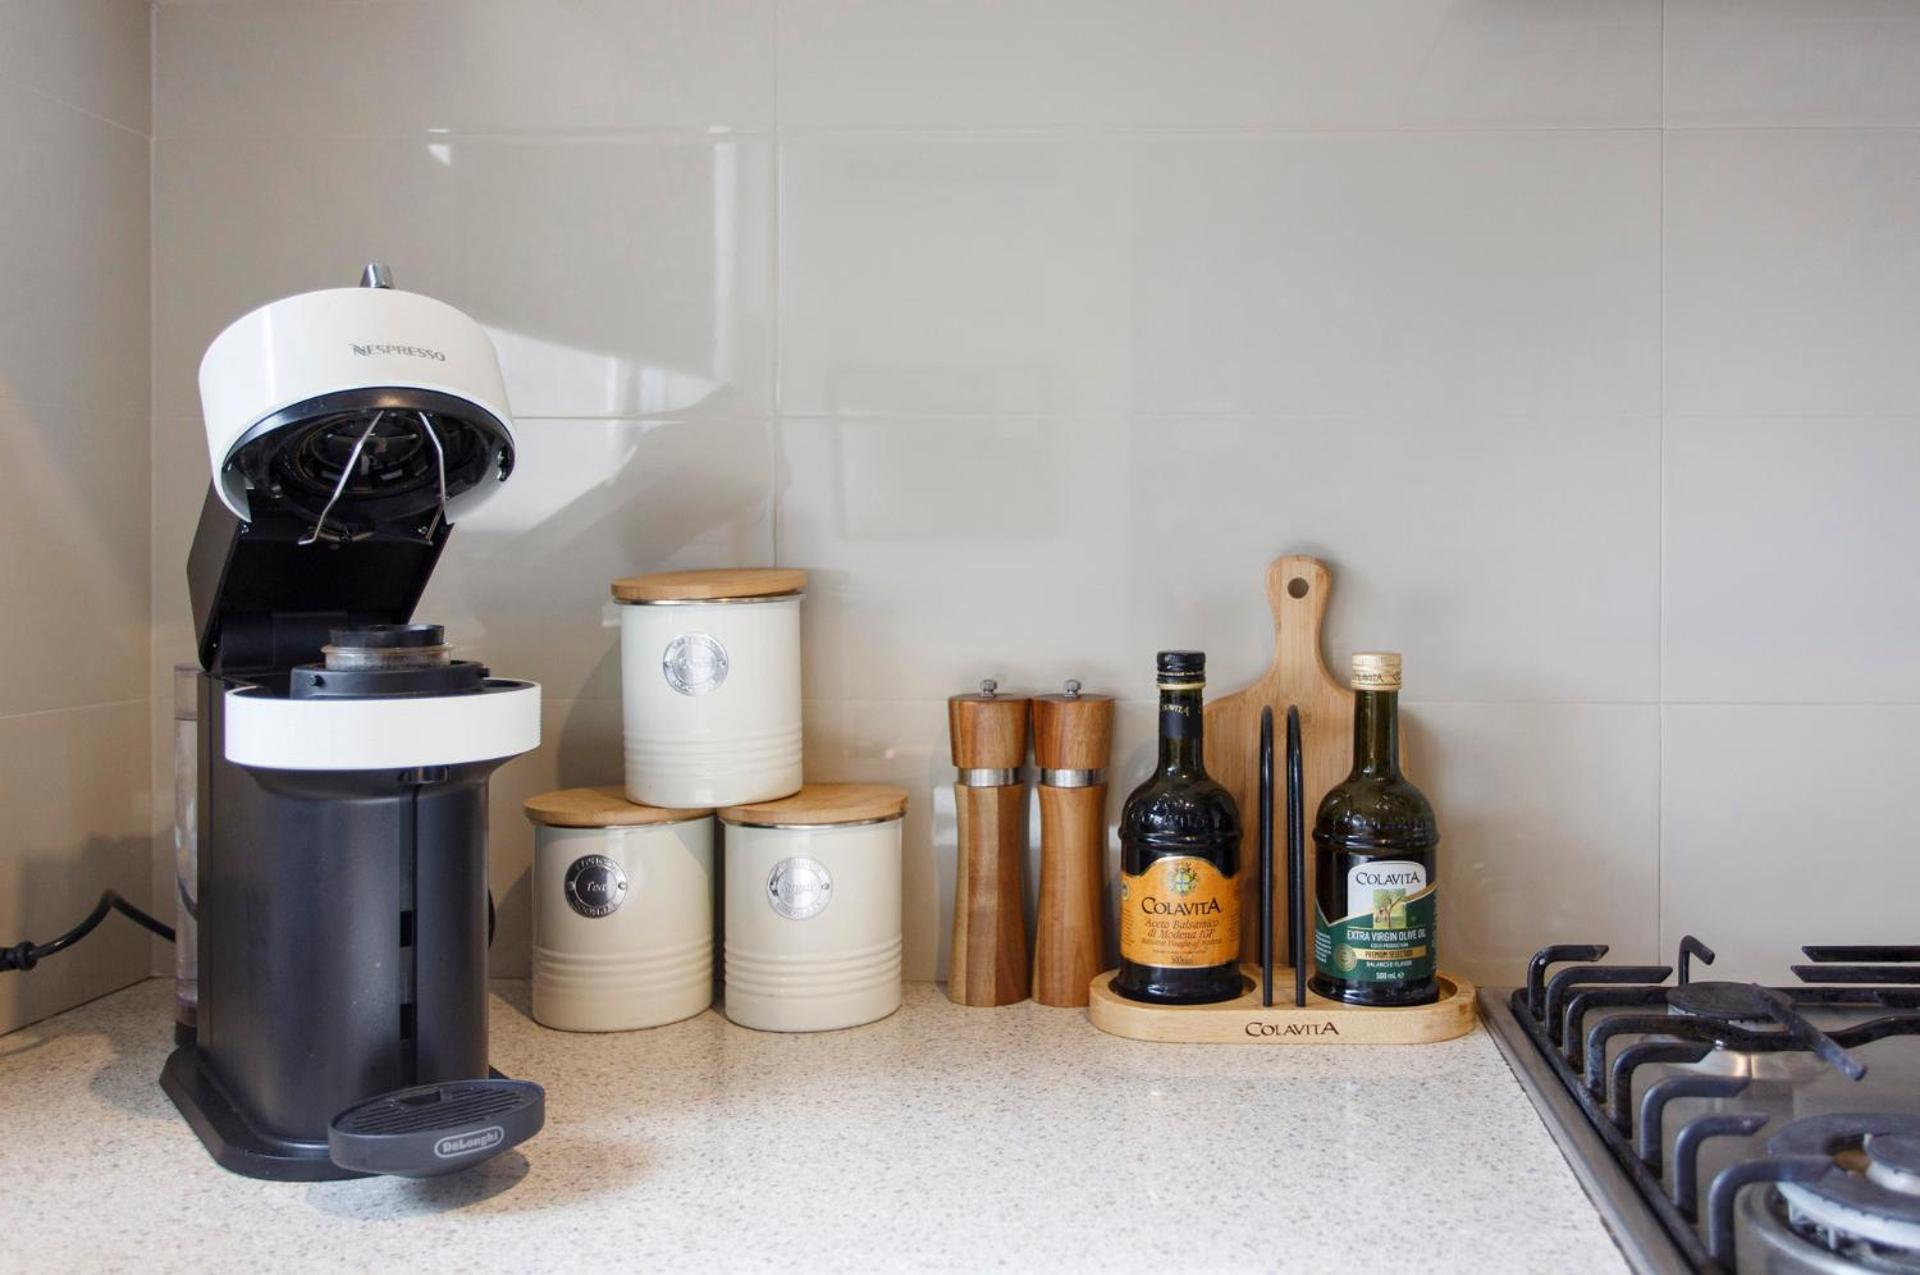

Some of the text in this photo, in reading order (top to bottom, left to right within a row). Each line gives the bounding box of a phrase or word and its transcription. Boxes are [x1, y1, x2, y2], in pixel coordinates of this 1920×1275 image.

[351, 344, 446, 361] NESPRESSO
[1355, 871, 1421, 885] COLAVITA
[1141, 897, 1221, 915] COLAVITA
[1347, 930, 1370, 941] EXTRA
[1371, 931, 1397, 942] VIRGIN
[1398, 930, 1417, 941] OLIVE
[1245, 1021, 1340, 1038] COLAVITA
